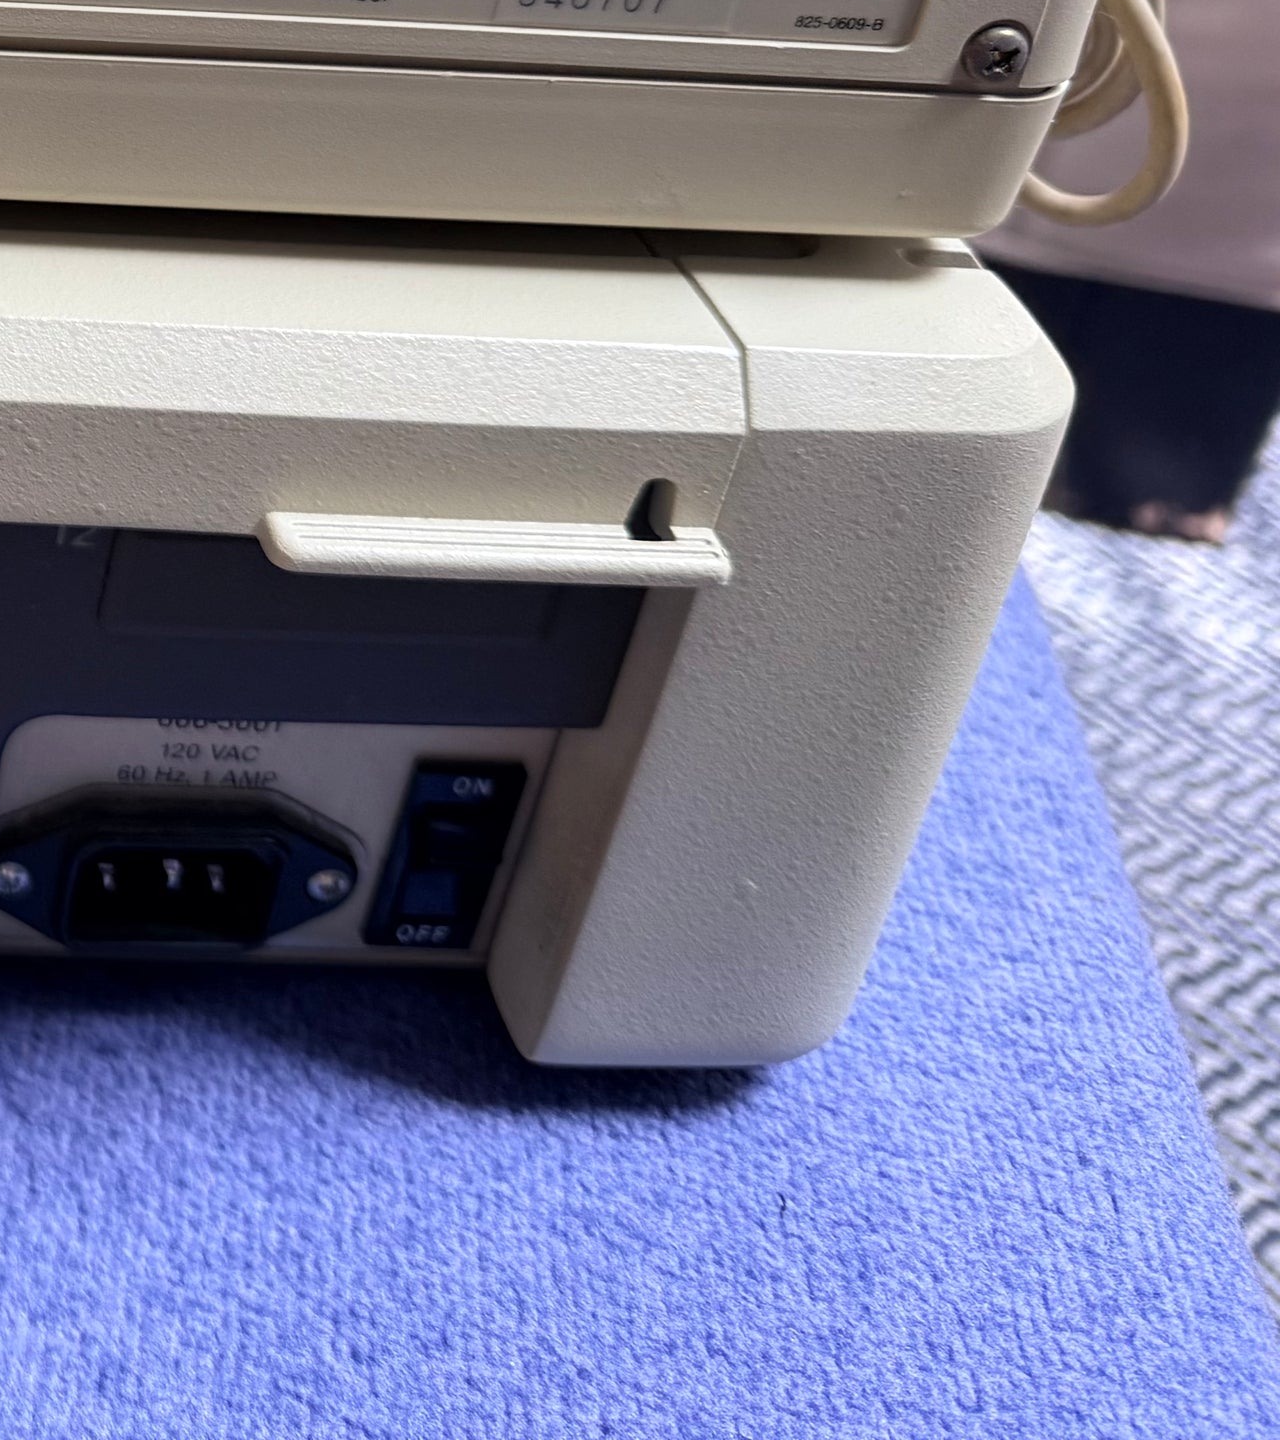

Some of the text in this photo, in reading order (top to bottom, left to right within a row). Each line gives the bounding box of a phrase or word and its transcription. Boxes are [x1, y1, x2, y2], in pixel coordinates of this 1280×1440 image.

[161, 742, 261, 763] 120 VAC
[116, 764, 146, 783] 60
[218, 769, 279, 790] AMP
[452, 776, 494, 798] ON
[395, 923, 451, 945] OFF
